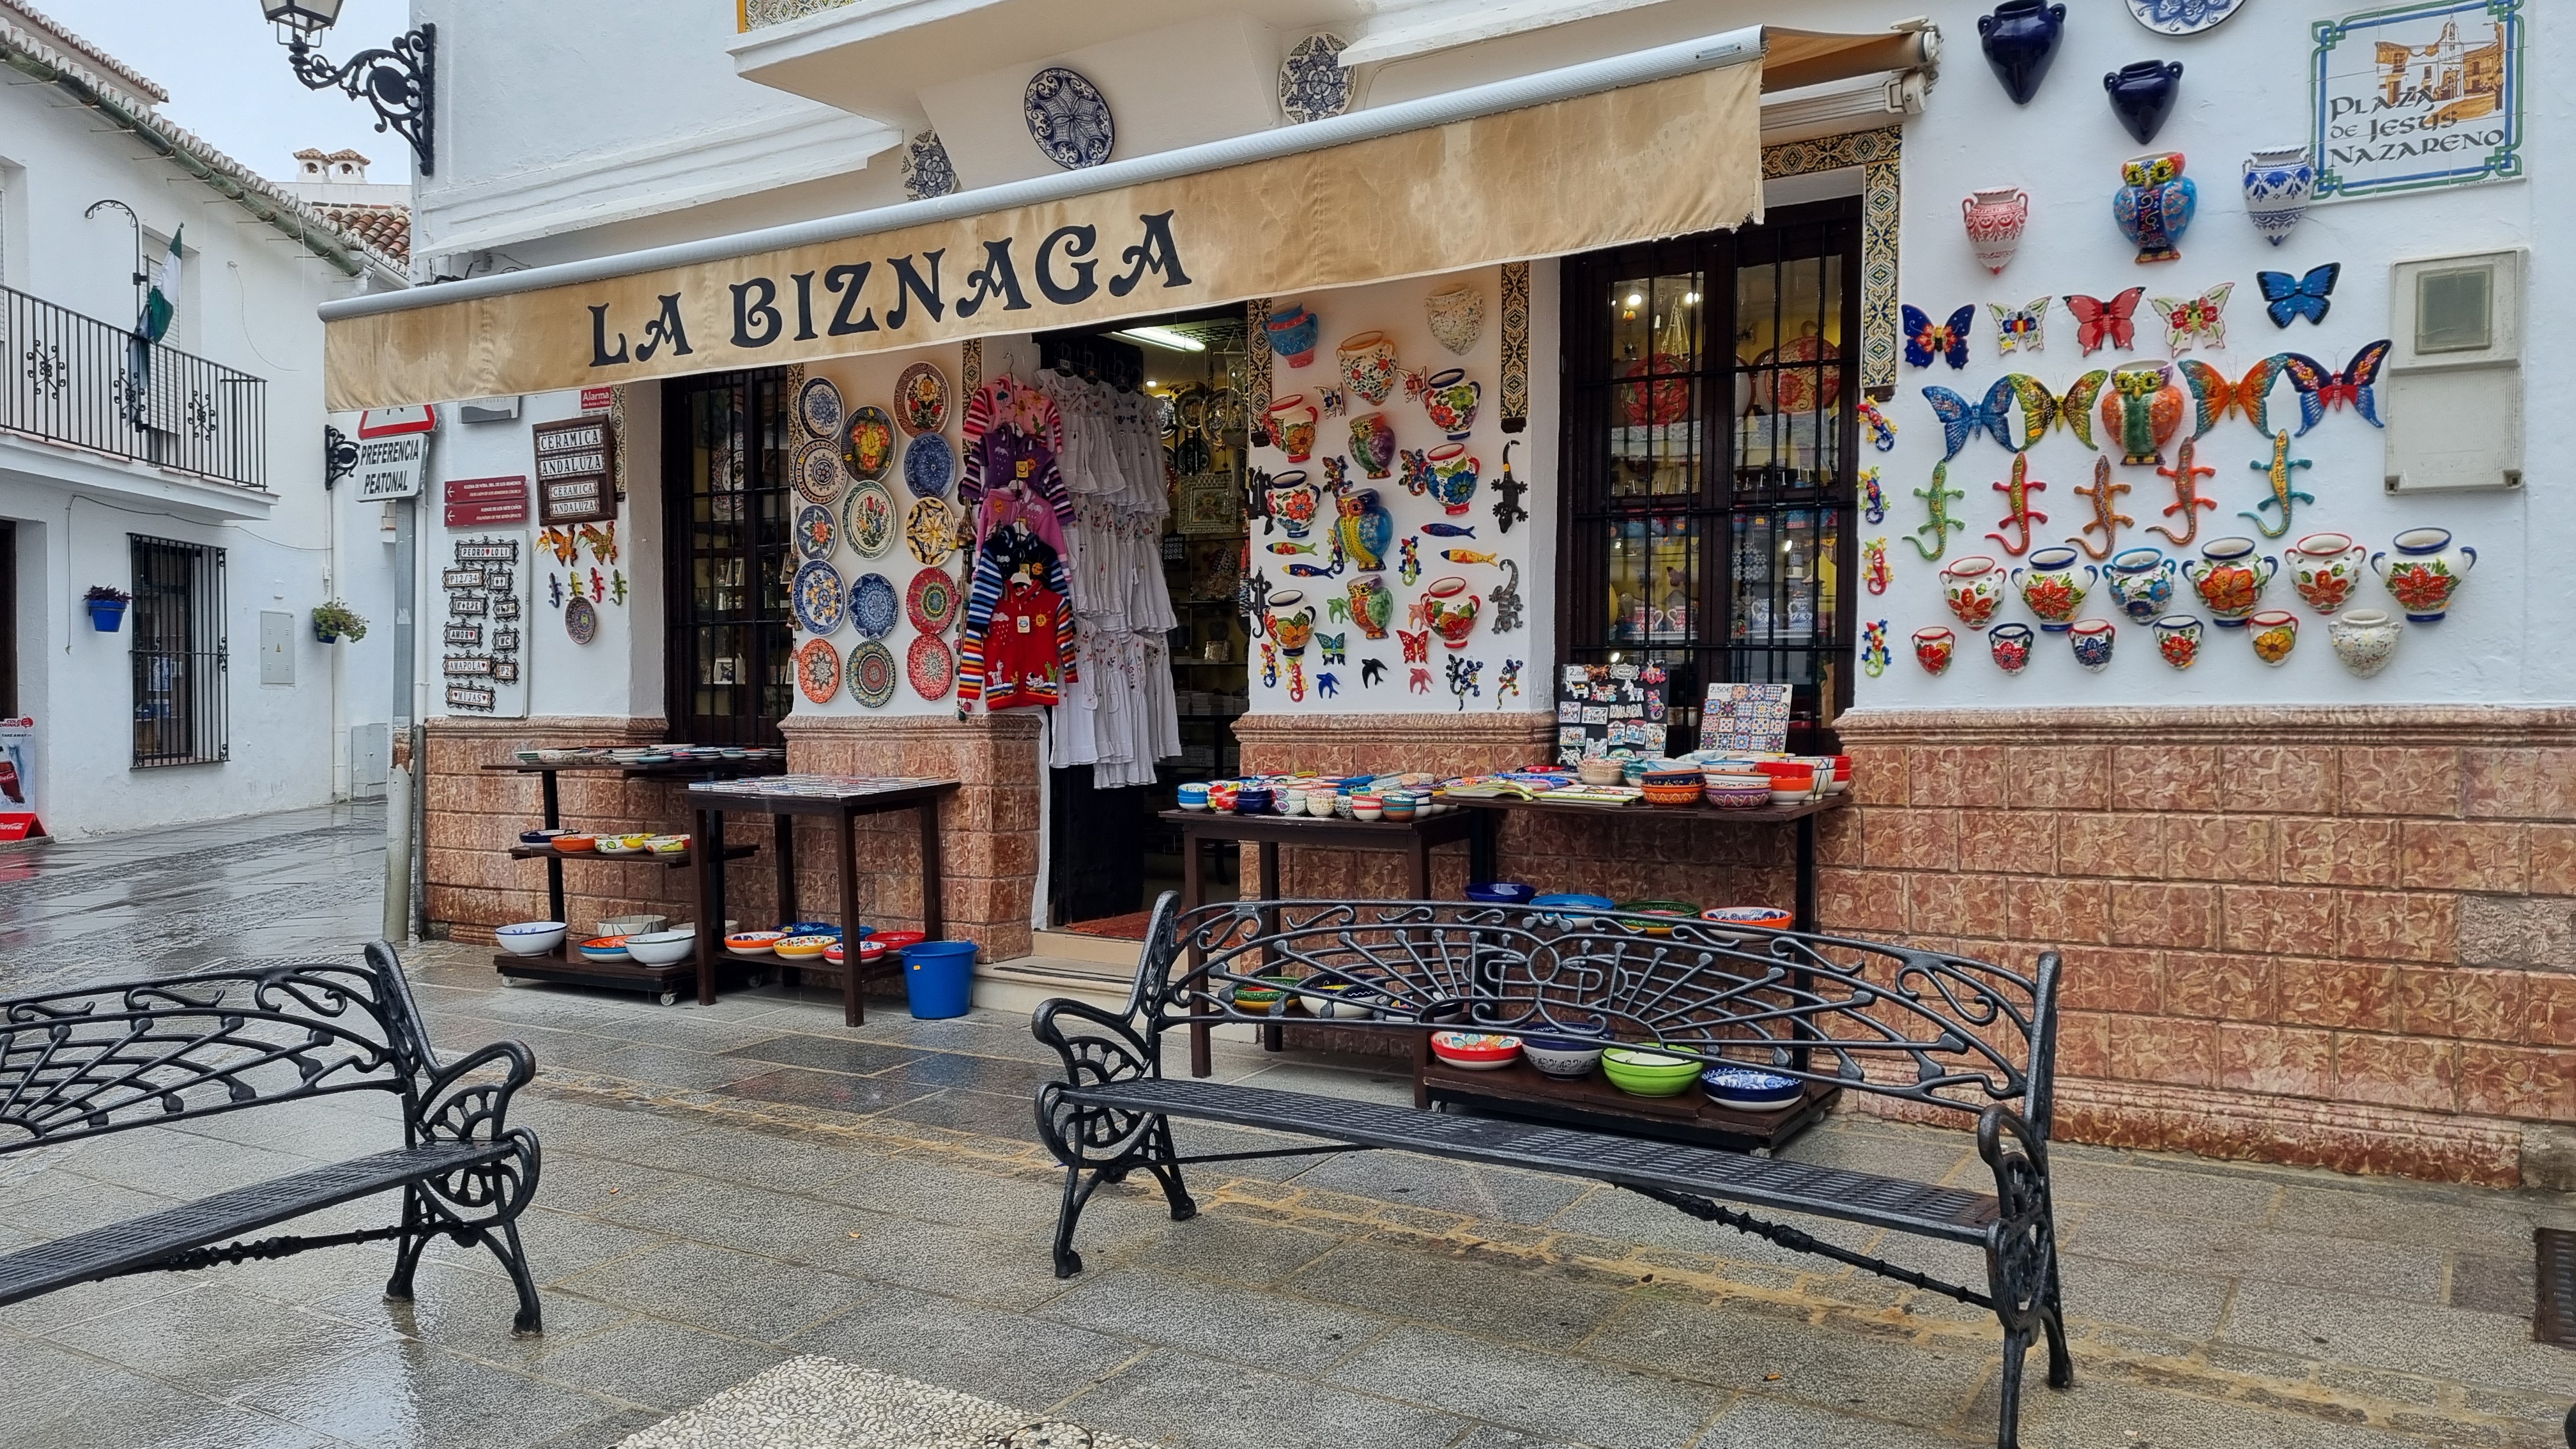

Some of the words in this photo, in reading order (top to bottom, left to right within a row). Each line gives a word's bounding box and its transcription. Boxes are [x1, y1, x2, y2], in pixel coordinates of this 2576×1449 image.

[2329, 89, 2435, 123] PLAZA
[2331, 125, 2358, 139] DE
[2328, 129, 2504, 167] NAZARENO
[588, 292, 693, 367] LA
[729, 209, 1192, 348] BIZNAGA
[582, 391, 610, 401] Alarma
[541, 430, 599, 449] CERAMICA
[360, 439, 418, 466] PREFERENCIA
[542, 456, 601, 474] ANDALUZA
[364, 470, 408, 494] PEATONAL
[553, 484, 593, 496] CERAMICA
[554, 501, 594, 513] ANDALUZA
[463, 548, 485, 556] PEDRO
[491, 548, 507, 556] LOLI
[451, 631, 469, 639] AMOR
[450, 661, 481, 670] AMAPOLA
[458, 692, 482, 702] MIJAS
